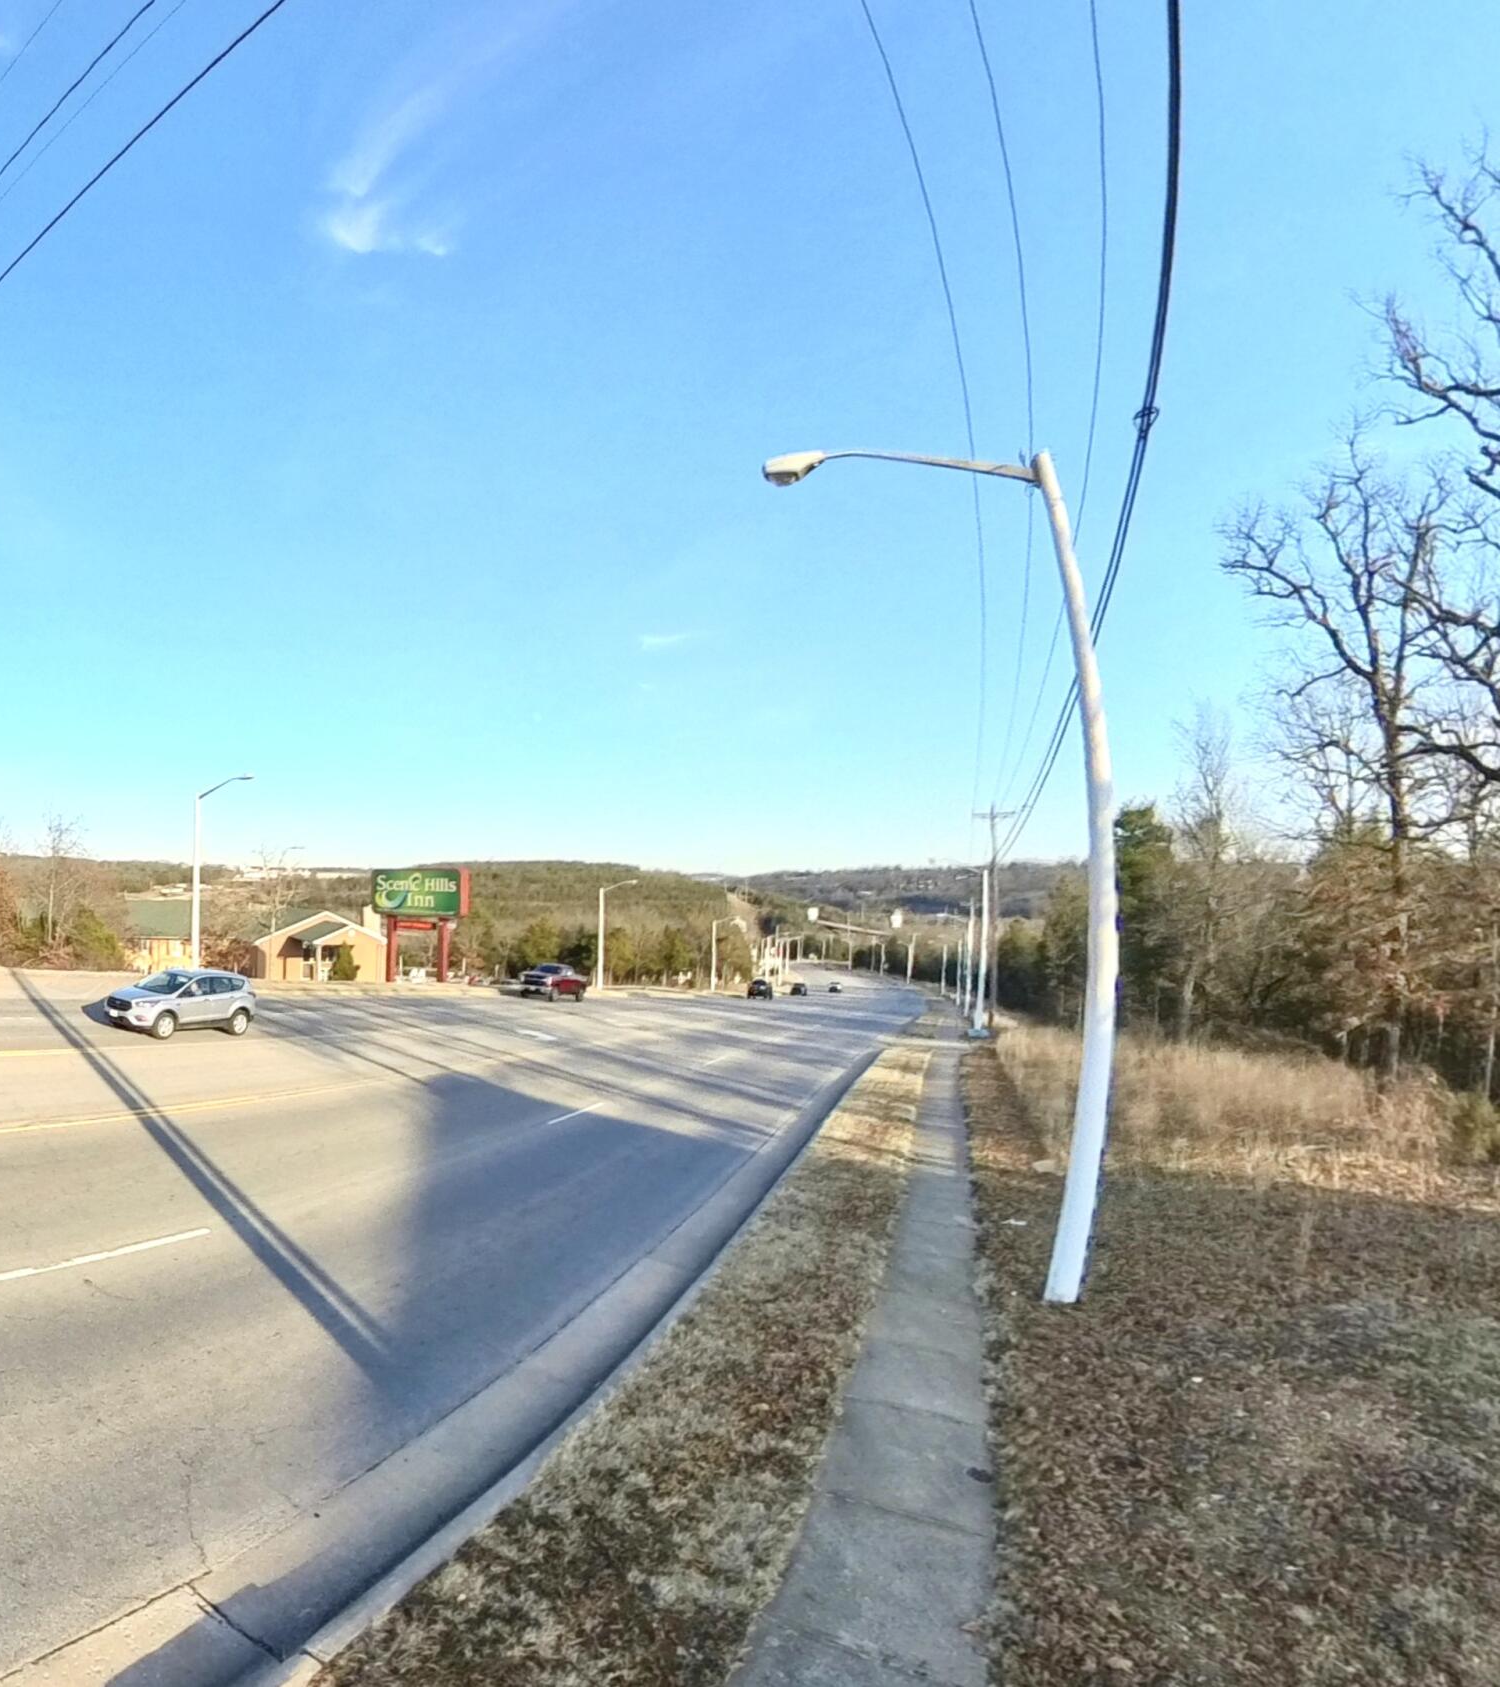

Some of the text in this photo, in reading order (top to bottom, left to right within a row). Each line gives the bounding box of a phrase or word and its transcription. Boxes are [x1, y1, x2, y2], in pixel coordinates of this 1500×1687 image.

[376, 872, 457, 893] Scenic Hills
[406, 892, 435, 908] Inn
